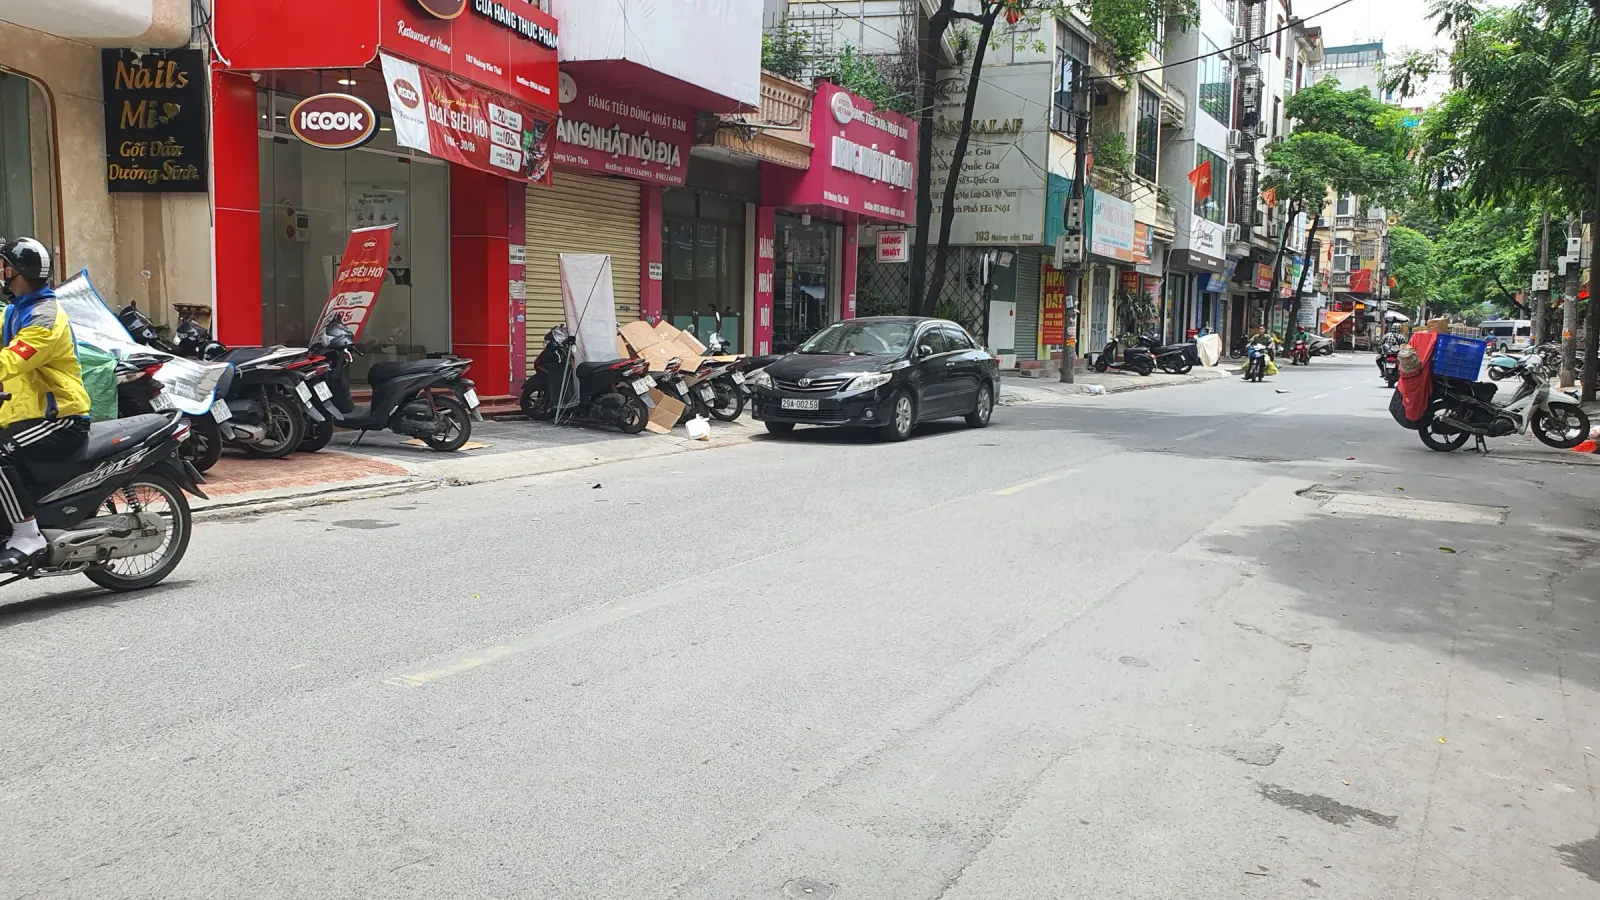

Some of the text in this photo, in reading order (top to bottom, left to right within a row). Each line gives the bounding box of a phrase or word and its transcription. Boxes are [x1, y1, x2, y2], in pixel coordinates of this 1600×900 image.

[494, 3, 516, 29] HÀNG
[517, 15, 537, 39] THỰC
[397, 20, 451, 54] Restaurant at Home
[115, 60, 188, 90] Nails
[120, 99, 158, 129] Mi
[450, 110, 473, 133] SIÊU
[588, 93, 610, 112] HÀNG
[611, 101, 629, 117] TIÊU
[630, 105, 651, 122] DÙNG
[652, 112, 671, 129] NHẬT
[556, 110, 680, 171] ÀNG NHẬT NỘI ĐỊA
[950, 149, 973, 158] Qốc
[976, 148, 991, 156] Gia
[109, 159, 199, 184] Dưỡng Sinh
[961, 160, 983, 172] Quốc
[985, 162, 999, 170] Gia
[973, 177, 988, 186] Quốc
[989, 176, 999, 184] Gia
[1003, 190, 1017, 198] Nam
[936, 202, 1010, 213] Tnh Phố Hà Nội
[759, 234, 773, 258] HÀNG
[881, 233, 901, 245] HÀNG
[975, 231, 990, 242] 193
[882, 248, 901, 258] NHẬT
[759, 270, 773, 296] NHẬT
[760, 303, 770, 330] NỘI
[782, 400, 819, 410] 29A-002.59
